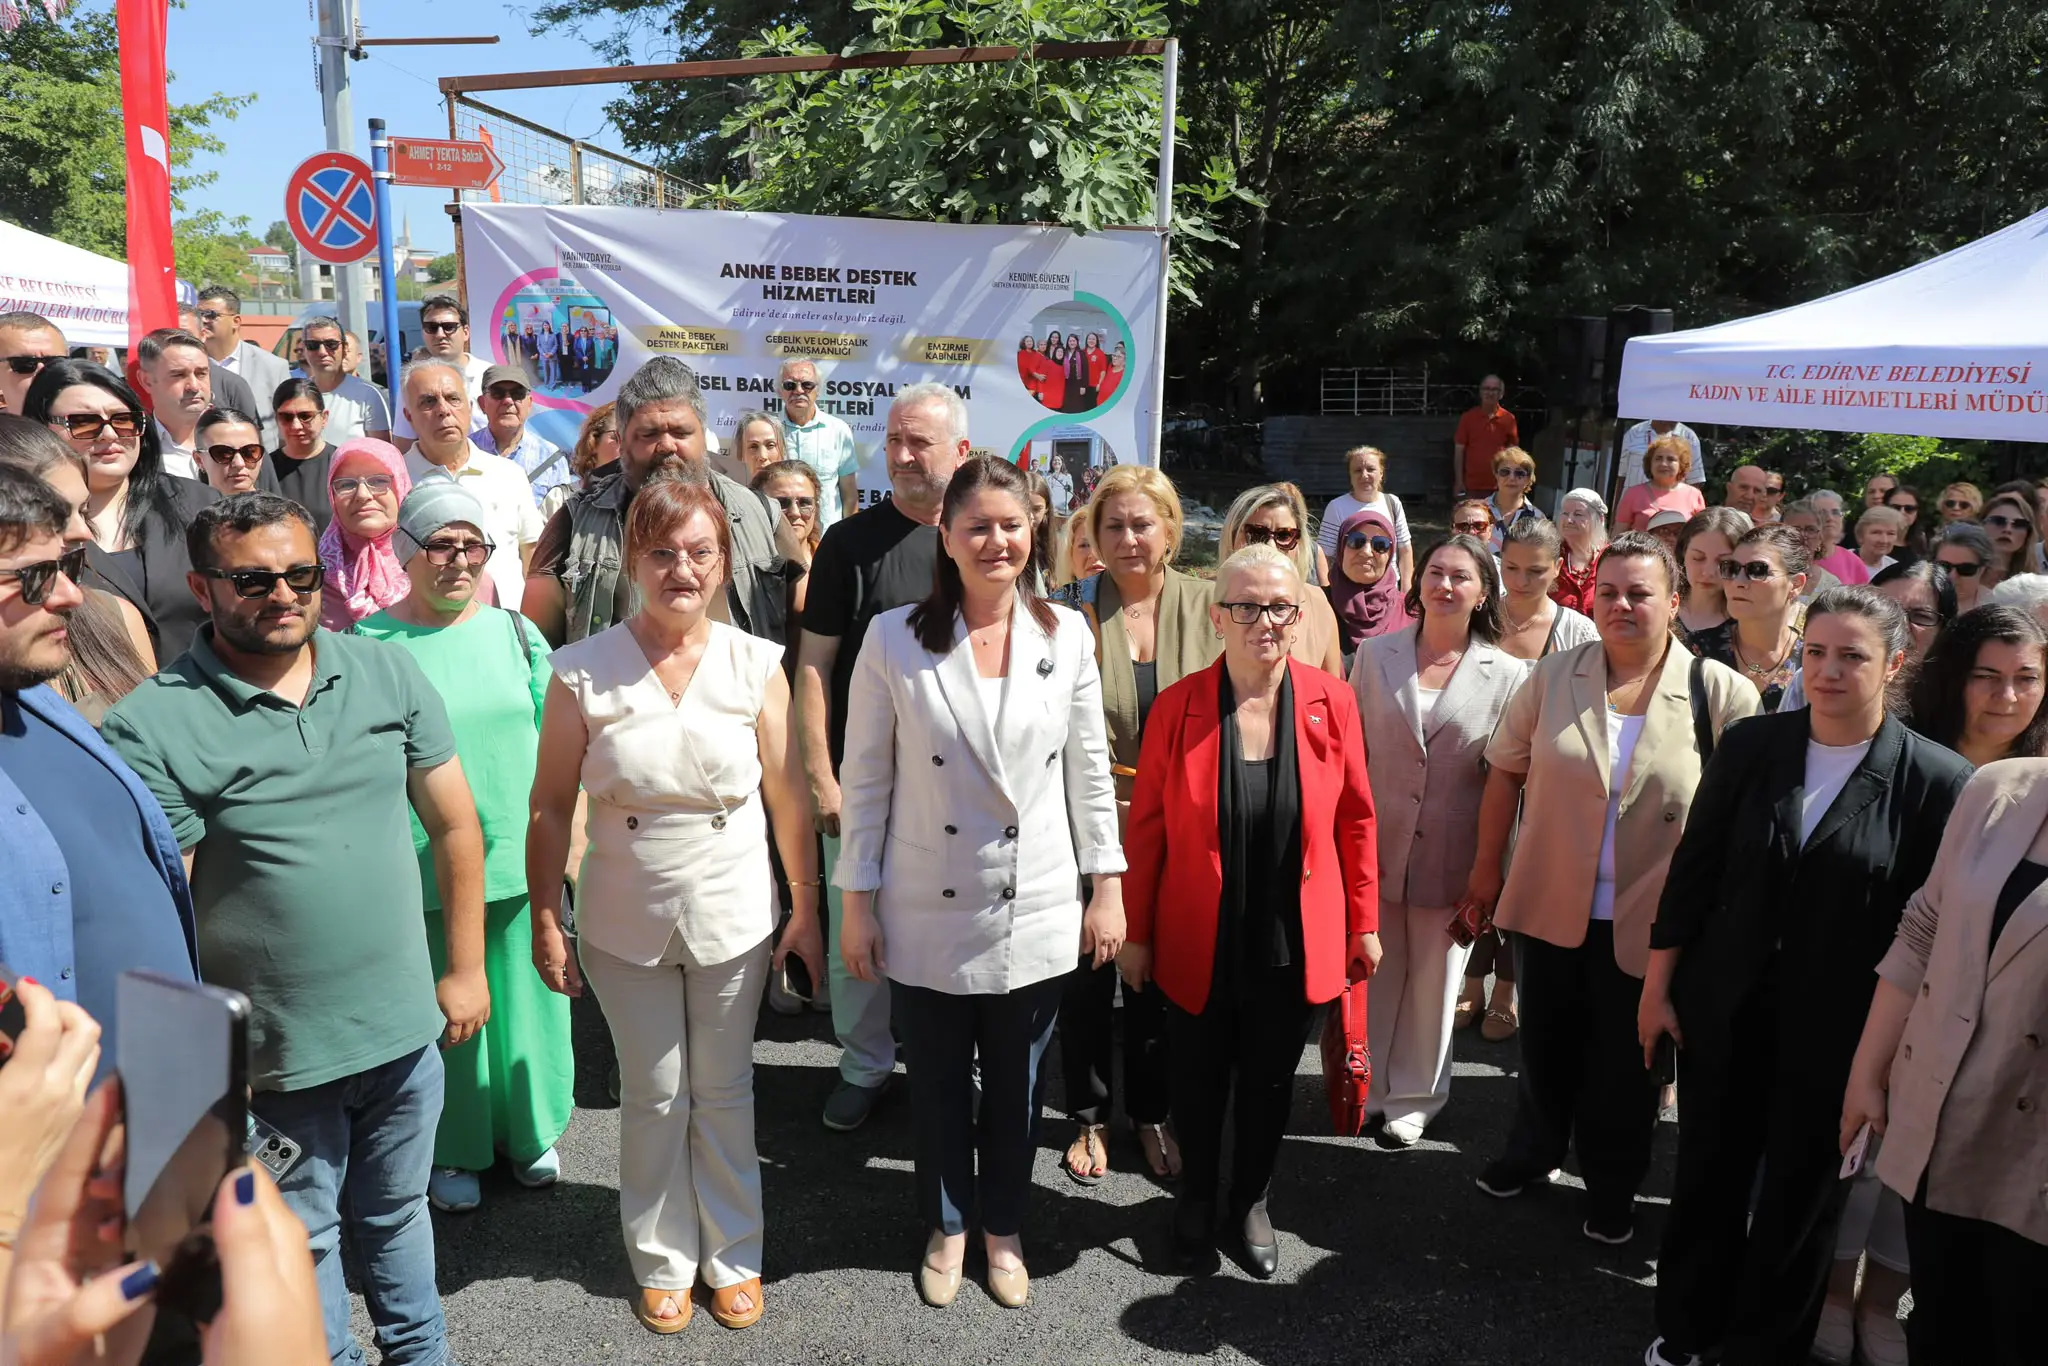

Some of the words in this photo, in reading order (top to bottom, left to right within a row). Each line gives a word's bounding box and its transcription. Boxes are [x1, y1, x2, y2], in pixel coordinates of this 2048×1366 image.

[409, 145, 434, 161] AHMET
[436, 147, 460, 162] YEKTA
[462, 148, 483, 163] Sokak
[562, 251, 612, 263] YANINIZDAYIZ
[720, 263, 776, 281] ANNE
[781, 265, 841, 283] BEBEK
[847, 268, 918, 287] DESTEK
[1009, 272, 1038, 282] KENDİNE
[1040, 273, 1070, 284] GÜVENEN
[763, 282, 876, 305] HİZMETLERİ
[73, 304, 129, 325] MÜDÜRL
[782, 311, 820, 321] anneler
[822, 312, 844, 322] asla
[878, 314, 906, 326] değil.
[659, 331, 686, 340] ANNE
[688, 332, 716, 341] BEBEK
[765, 333, 801, 344] GEBELİK
[804, 336, 816, 345] VE
[818, 337, 868, 347] LOHUSALIK
[647, 339, 681, 349] DESTEK
[682, 341, 729, 351] PAKETLERİ
[783, 345, 851, 356] DANIŞMANLIĞI
[928, 342, 968, 352] EMZİRME
[925, 352, 971, 361] KABİNLERİ
[1766, 364, 1795, 379] T.C.
[1802, 361, 1883, 381] EDİRNE
[1886, 361, 2032, 384] BELEDİYESİ
[695, 371, 731, 391] İSEL
[737, 377, 775, 393] BAK
[826, 380, 897, 398] SOSYAL
[1689, 384, 1742, 401] KADIN
[1748, 386, 1769, 403] VE
[1774, 384, 1816, 405] AİLE
[1822, 386, 1958, 411] HİZMETLERİ
[1965, 388, 2048, 413] MÜDÜ
